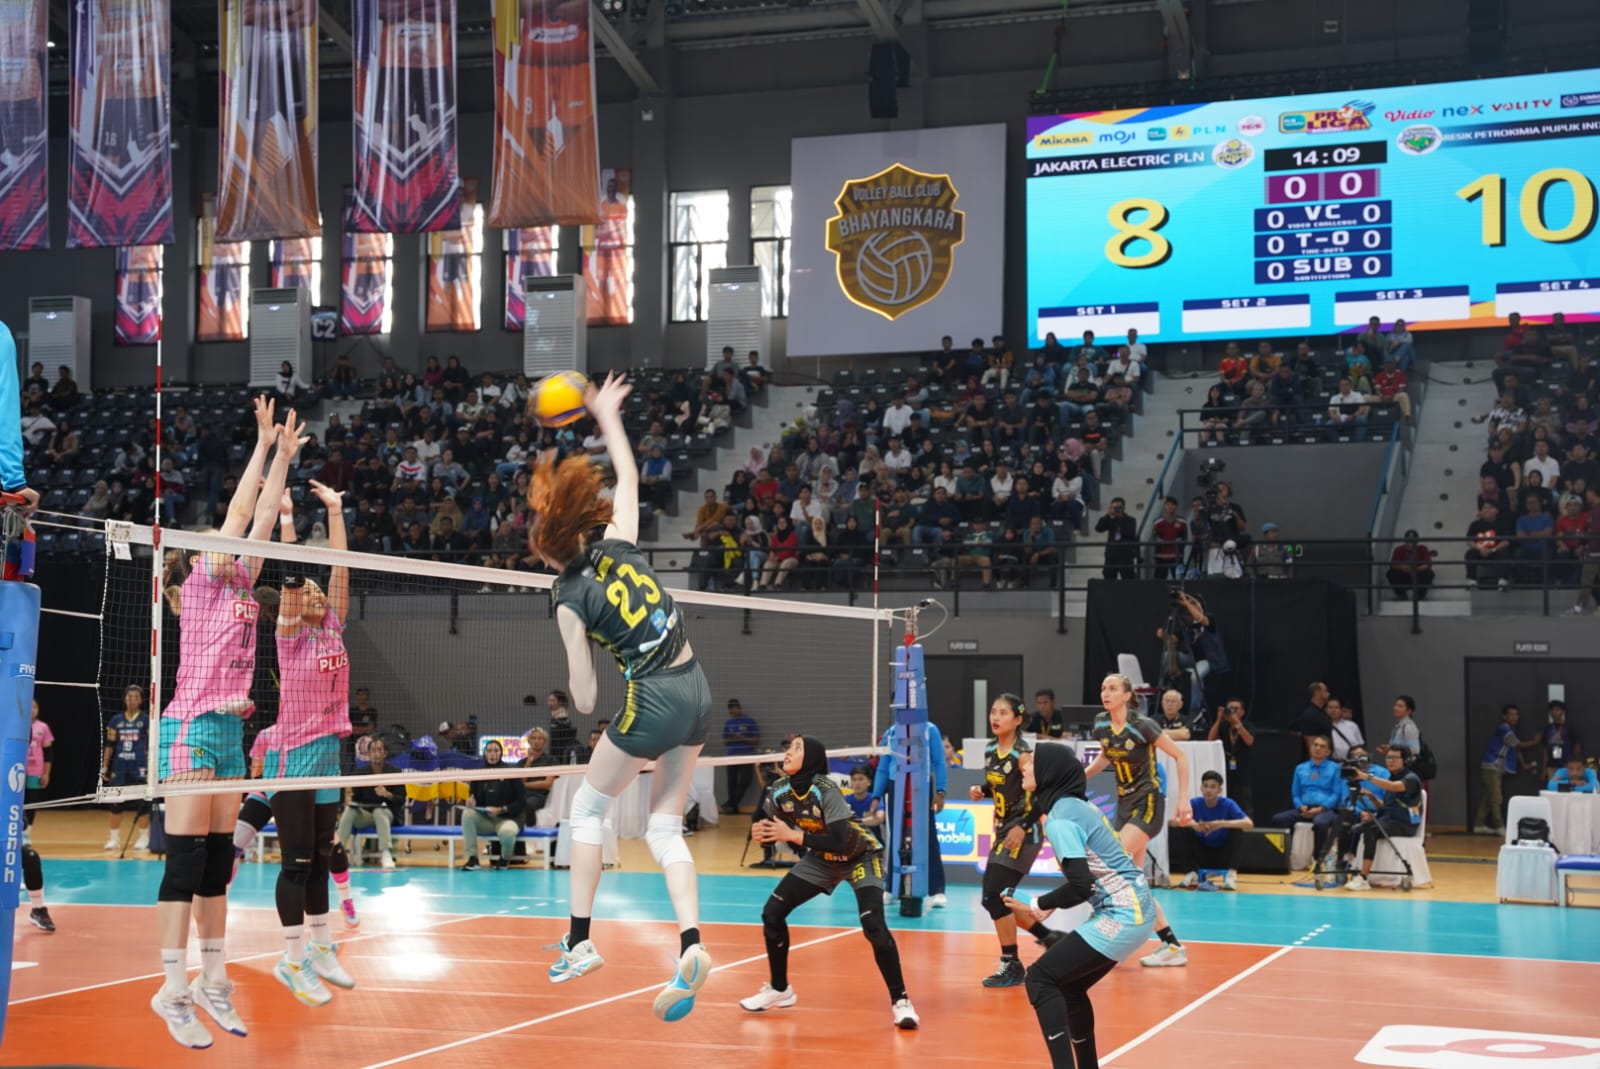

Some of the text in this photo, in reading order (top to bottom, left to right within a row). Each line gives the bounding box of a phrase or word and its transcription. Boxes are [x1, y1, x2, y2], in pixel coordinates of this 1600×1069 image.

[1442, 104, 1485, 118] nex
[1532, 98, 1554, 110] TV
[1384, 109, 1435, 123] Vidio
[1193, 124, 1227, 136] PLN
[1474, 127, 1541, 140] PETROKIMIA
[1541, 122, 1581, 136] PUPUK
[1034, 159, 1098, 176] JAKARTA
[1101, 153, 1171, 170] ELECTRIC
[1174, 151, 1205, 164] PLN
[1292, 147, 1361, 166] 14:09
[853, 183, 941, 201] VOLLEY BALL CLUB
[1284, 176, 1306, 199] 0
[1340, 172, 1362, 195] 0
[1456, 166, 1599, 247] 10
[838, 207, 956, 237] BHAYANGKARA
[1267, 204, 1381, 229] 0 VC 0
[1104, 196, 1173, 269] 8
[1267, 236, 1285, 254] 0
[1363, 230, 1381, 248] 0
[1267, 256, 1381, 280] 0 SUB 0
[1540, 279, 1590, 291] SET 4
[1221, 297, 1267, 309] SET 2
[1375, 289, 1424, 301] SET 3
[1076, 304, 1117, 316] SET 1
[606, 563, 661, 629] 23
[319, 654, 349, 673] PLUS
[1113, 760, 1134, 783] 11
